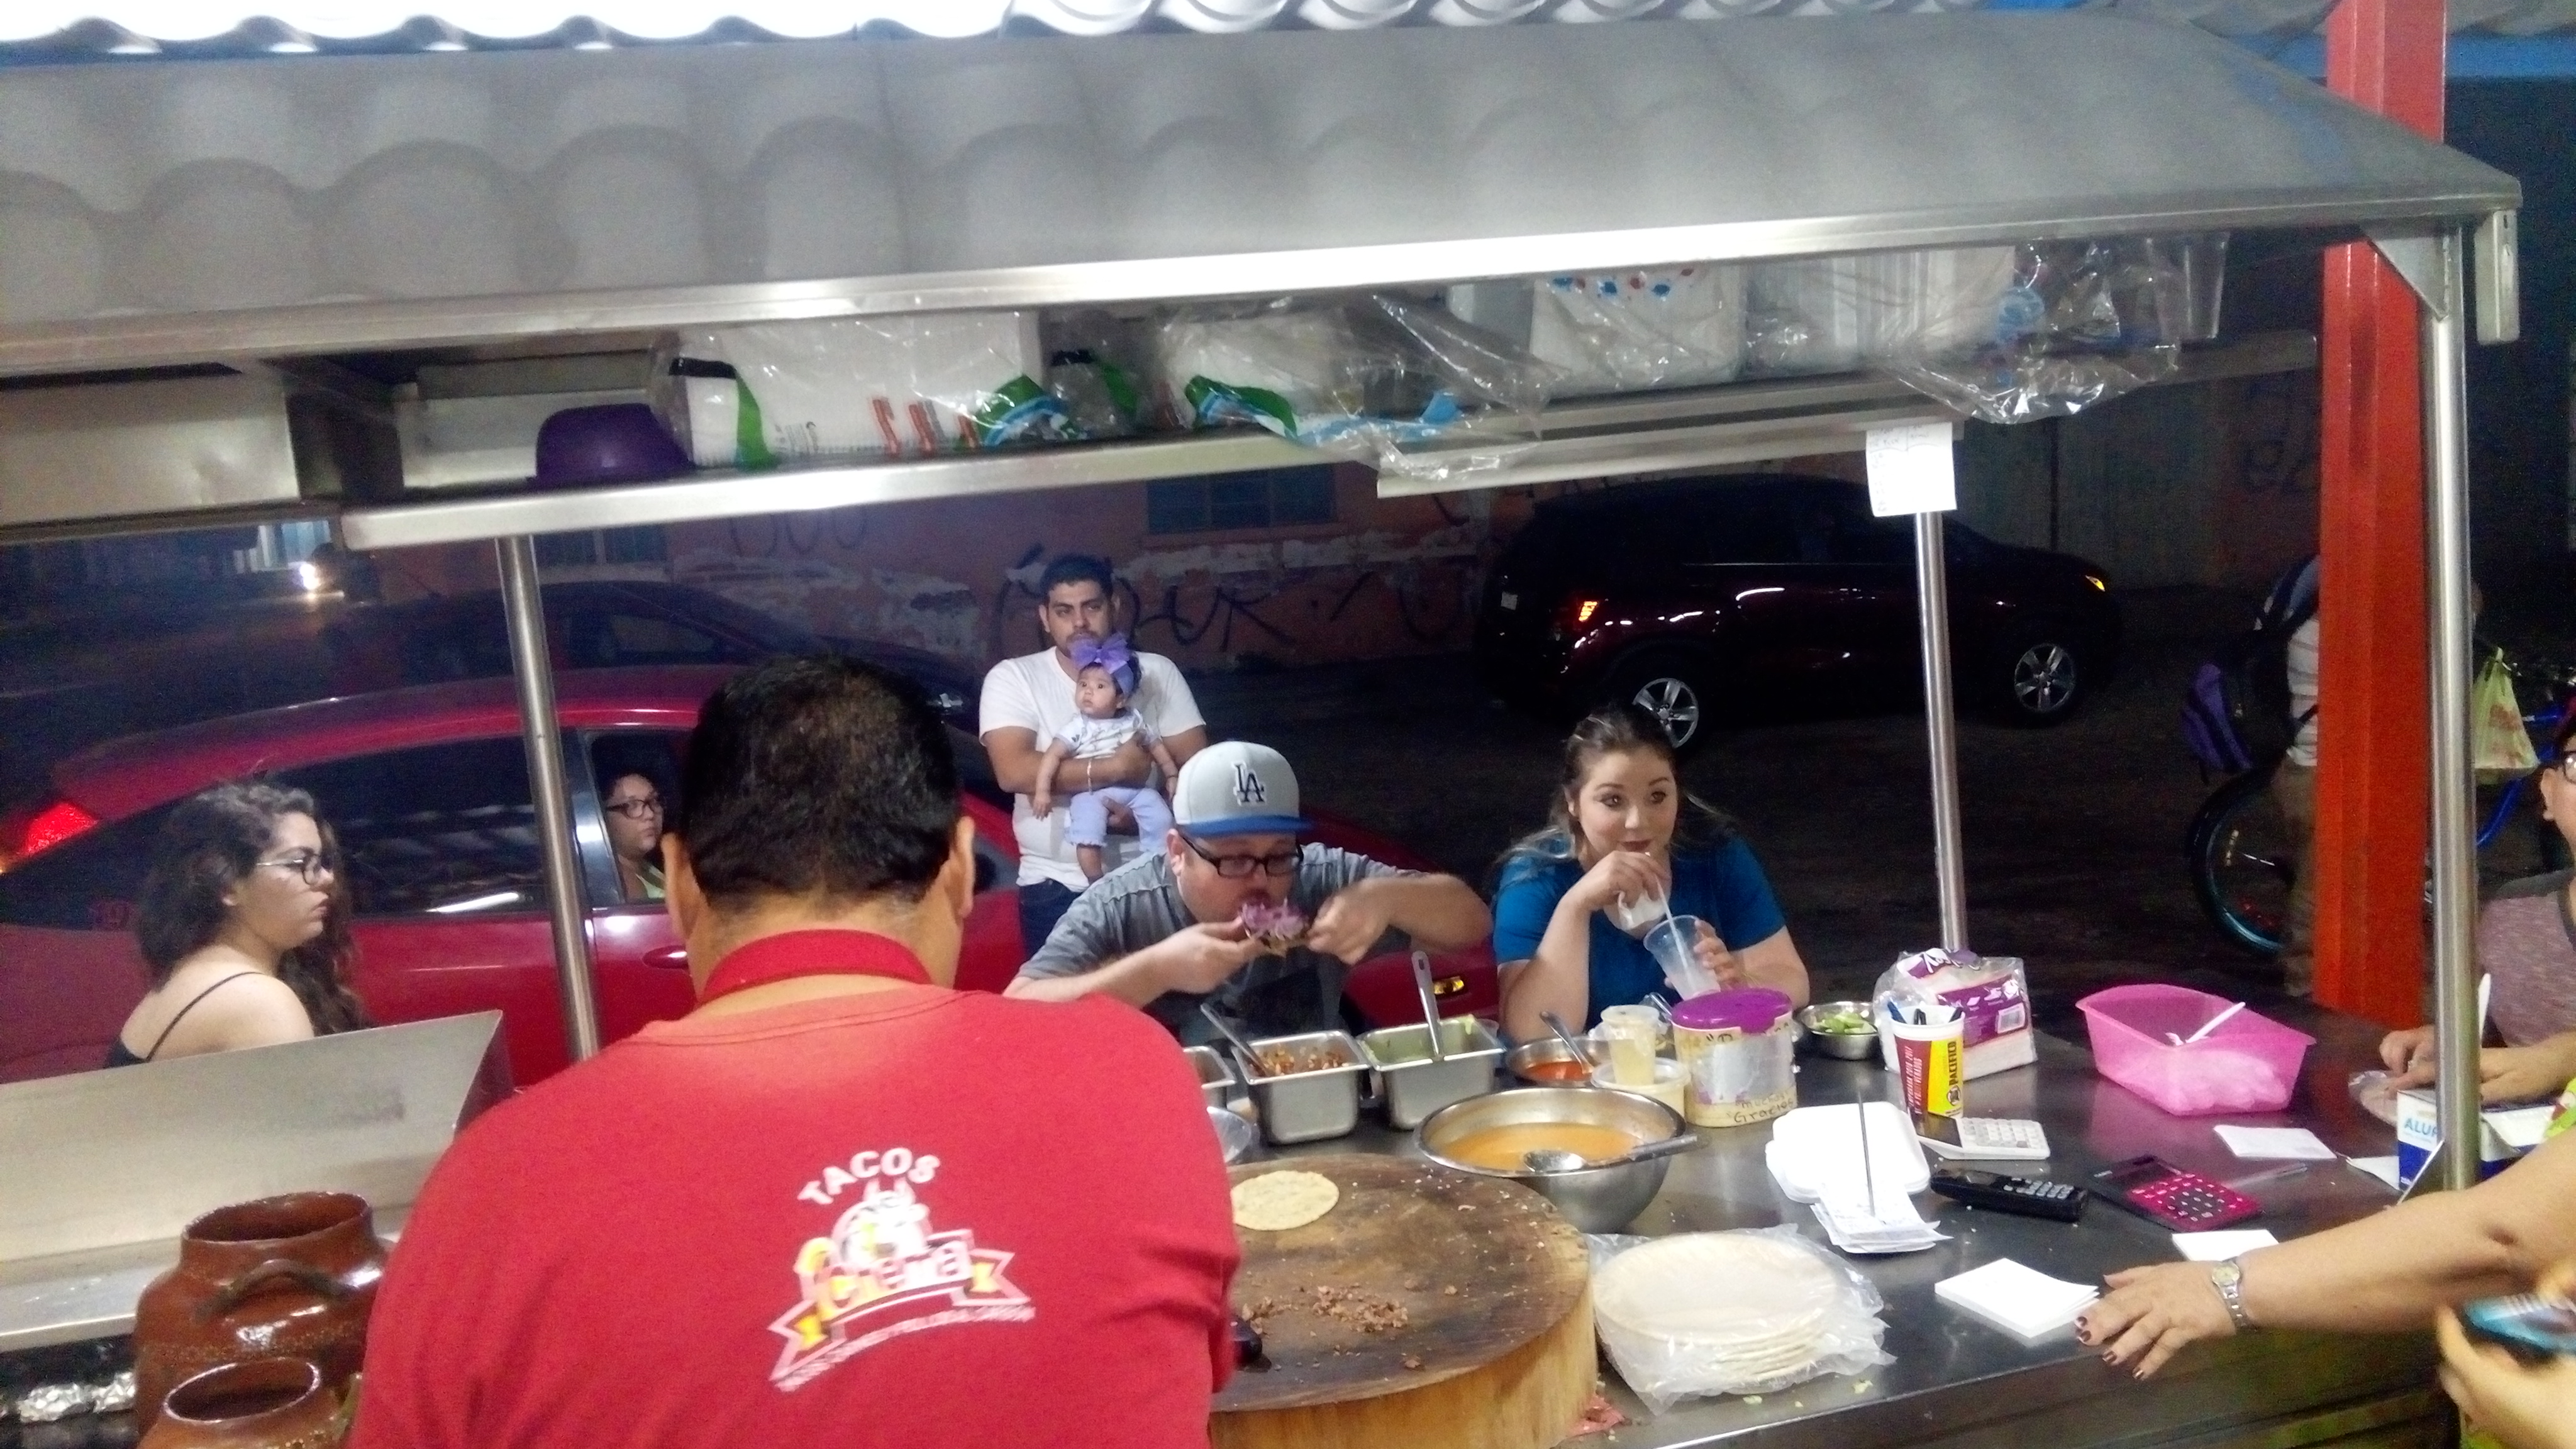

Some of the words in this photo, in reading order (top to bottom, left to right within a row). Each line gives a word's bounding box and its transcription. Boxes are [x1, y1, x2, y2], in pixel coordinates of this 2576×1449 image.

[1234, 763, 1265, 804] LA
[1947, 1041, 1958, 1086] PACIFICO
[797, 1146, 941, 1205] TACOS
